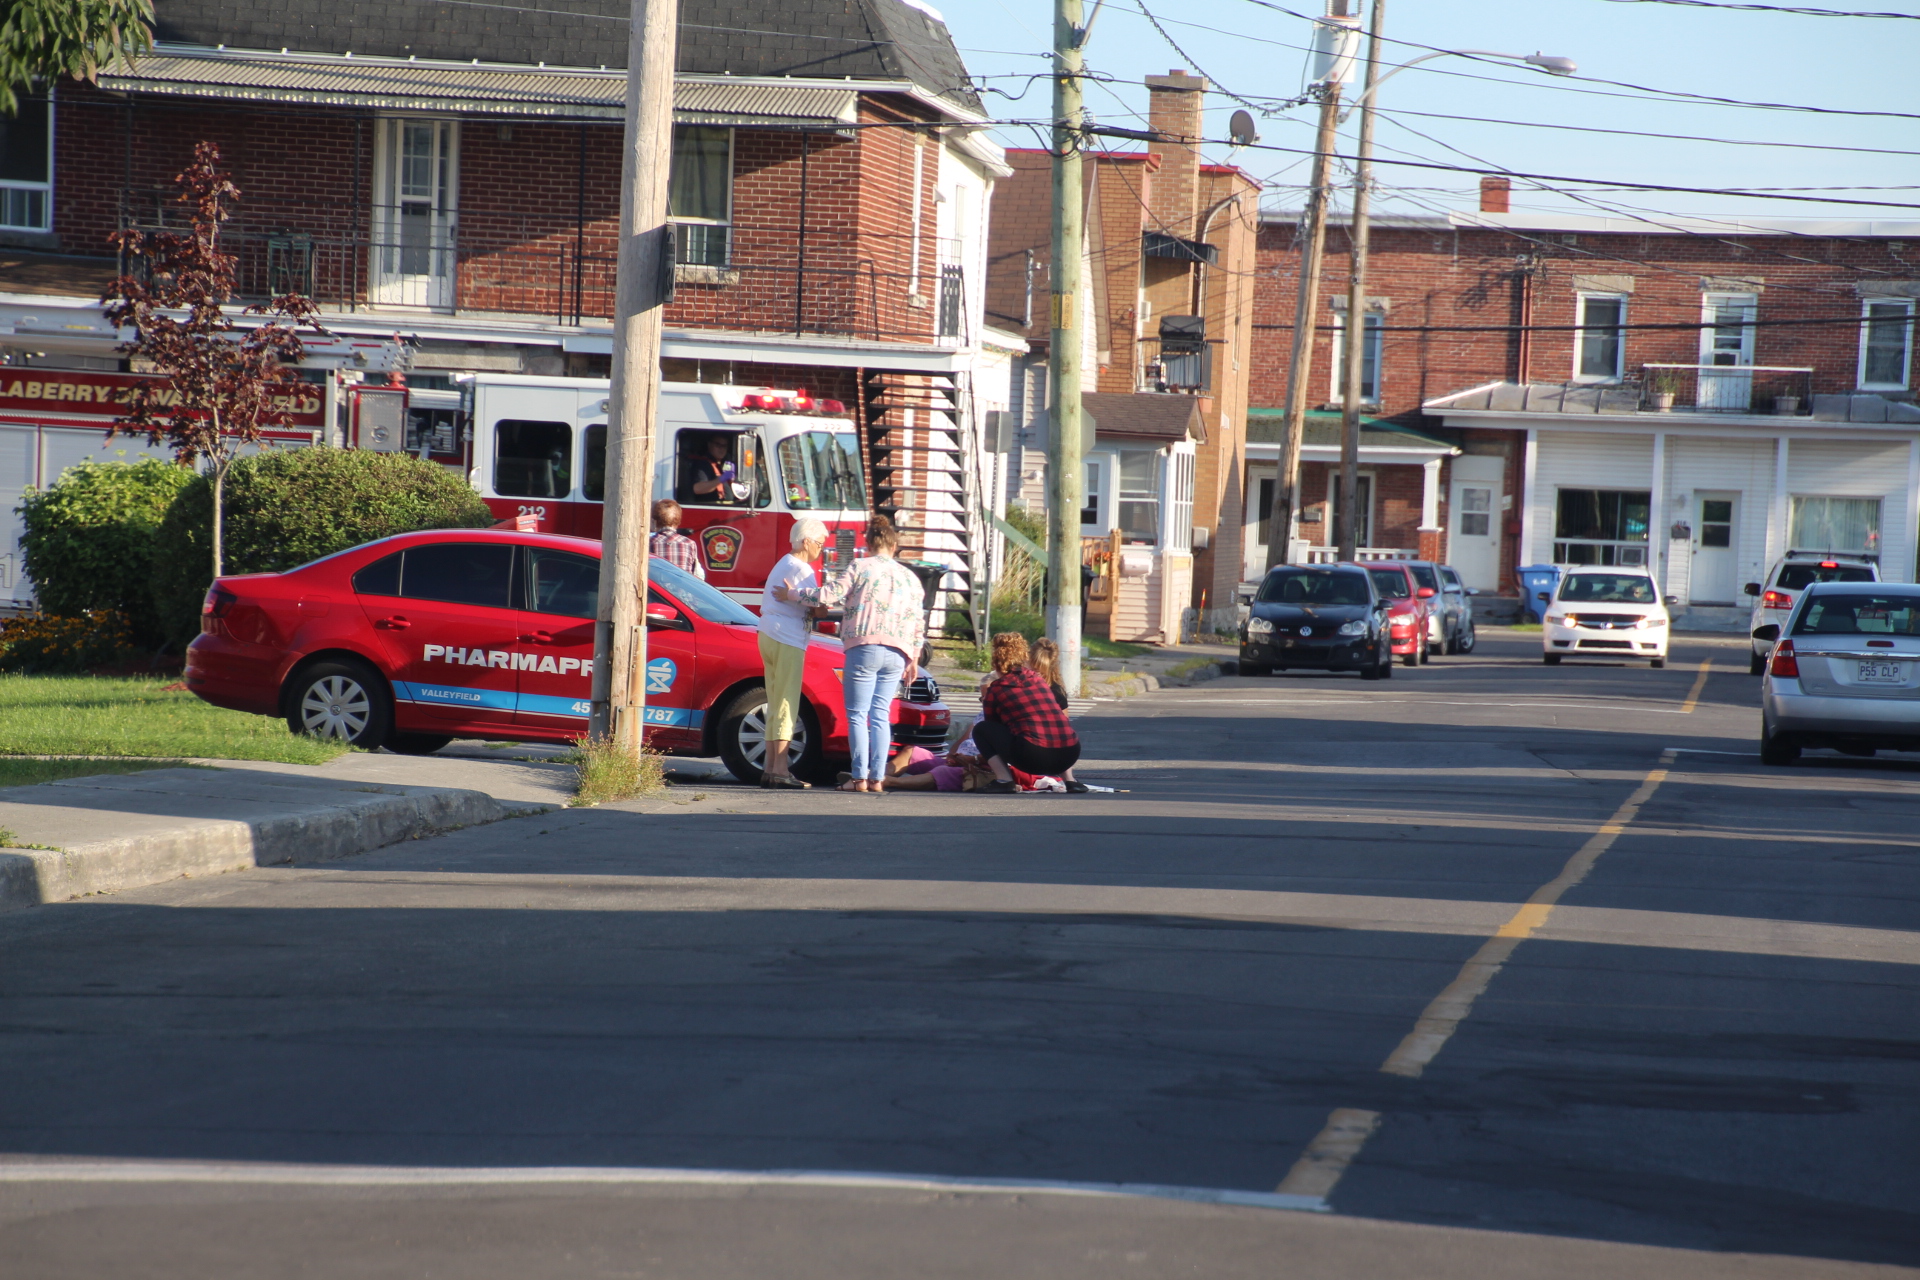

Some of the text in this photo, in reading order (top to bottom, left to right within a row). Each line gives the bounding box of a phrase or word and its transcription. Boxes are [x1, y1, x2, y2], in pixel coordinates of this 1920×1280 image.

[518, 505, 546, 520] 212
[423, 644, 593, 677] PHARMAPR
[1860, 666, 1899, 677] P55 CLP
[421, 689, 481, 701] VALLEYFIELD
[571, 702, 674, 721] 45 787
